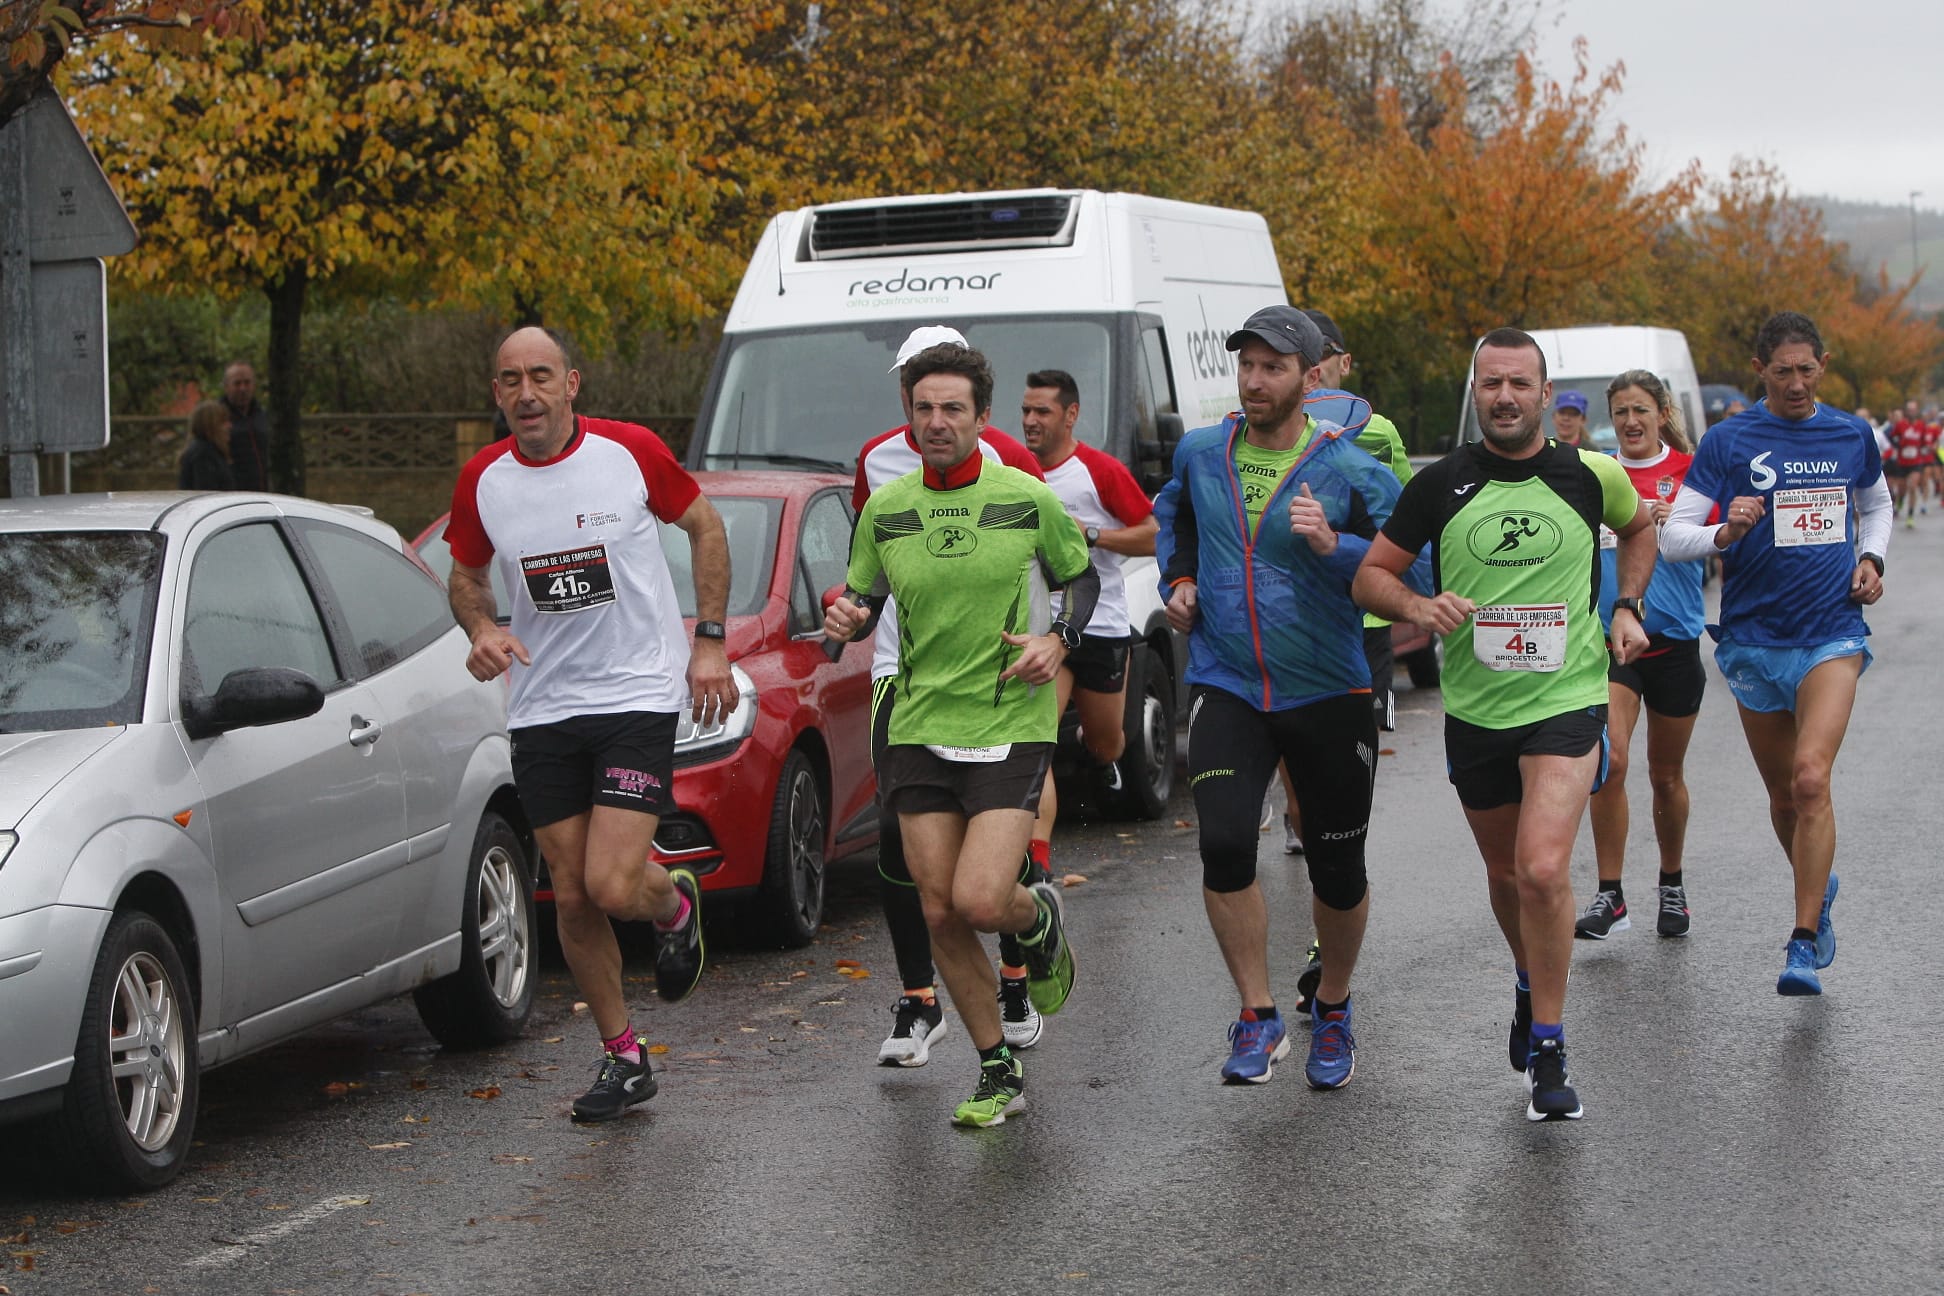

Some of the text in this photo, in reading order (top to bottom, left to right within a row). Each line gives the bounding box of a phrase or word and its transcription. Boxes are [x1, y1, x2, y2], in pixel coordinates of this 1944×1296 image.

[848, 268, 1002, 296] redamar
[846, 295, 950, 308] alta gastronomia
[1239, 463, 1277, 478] Joma
[1783, 461, 1838, 474] SOLVAY
[1778, 496, 1800, 504] CARRERA
[1809, 494, 1819, 502] LAS
[1820, 492, 1843, 501] EMPRESAS
[929, 507, 970, 519] Joma
[1802, 530, 1825, 538] SOLVAY
[524, 549, 603, 570] CARRERA DE LAS EMPRESAS
[1484, 555, 1546, 568] BRIDGESTONE
[587, 588, 614, 599] CASTINGS
[1478, 610, 1562, 621] CARRERA DE LAS EMPRESAS
[605, 767, 661, 788] VENTURA
[618, 780, 648, 793] SKY
